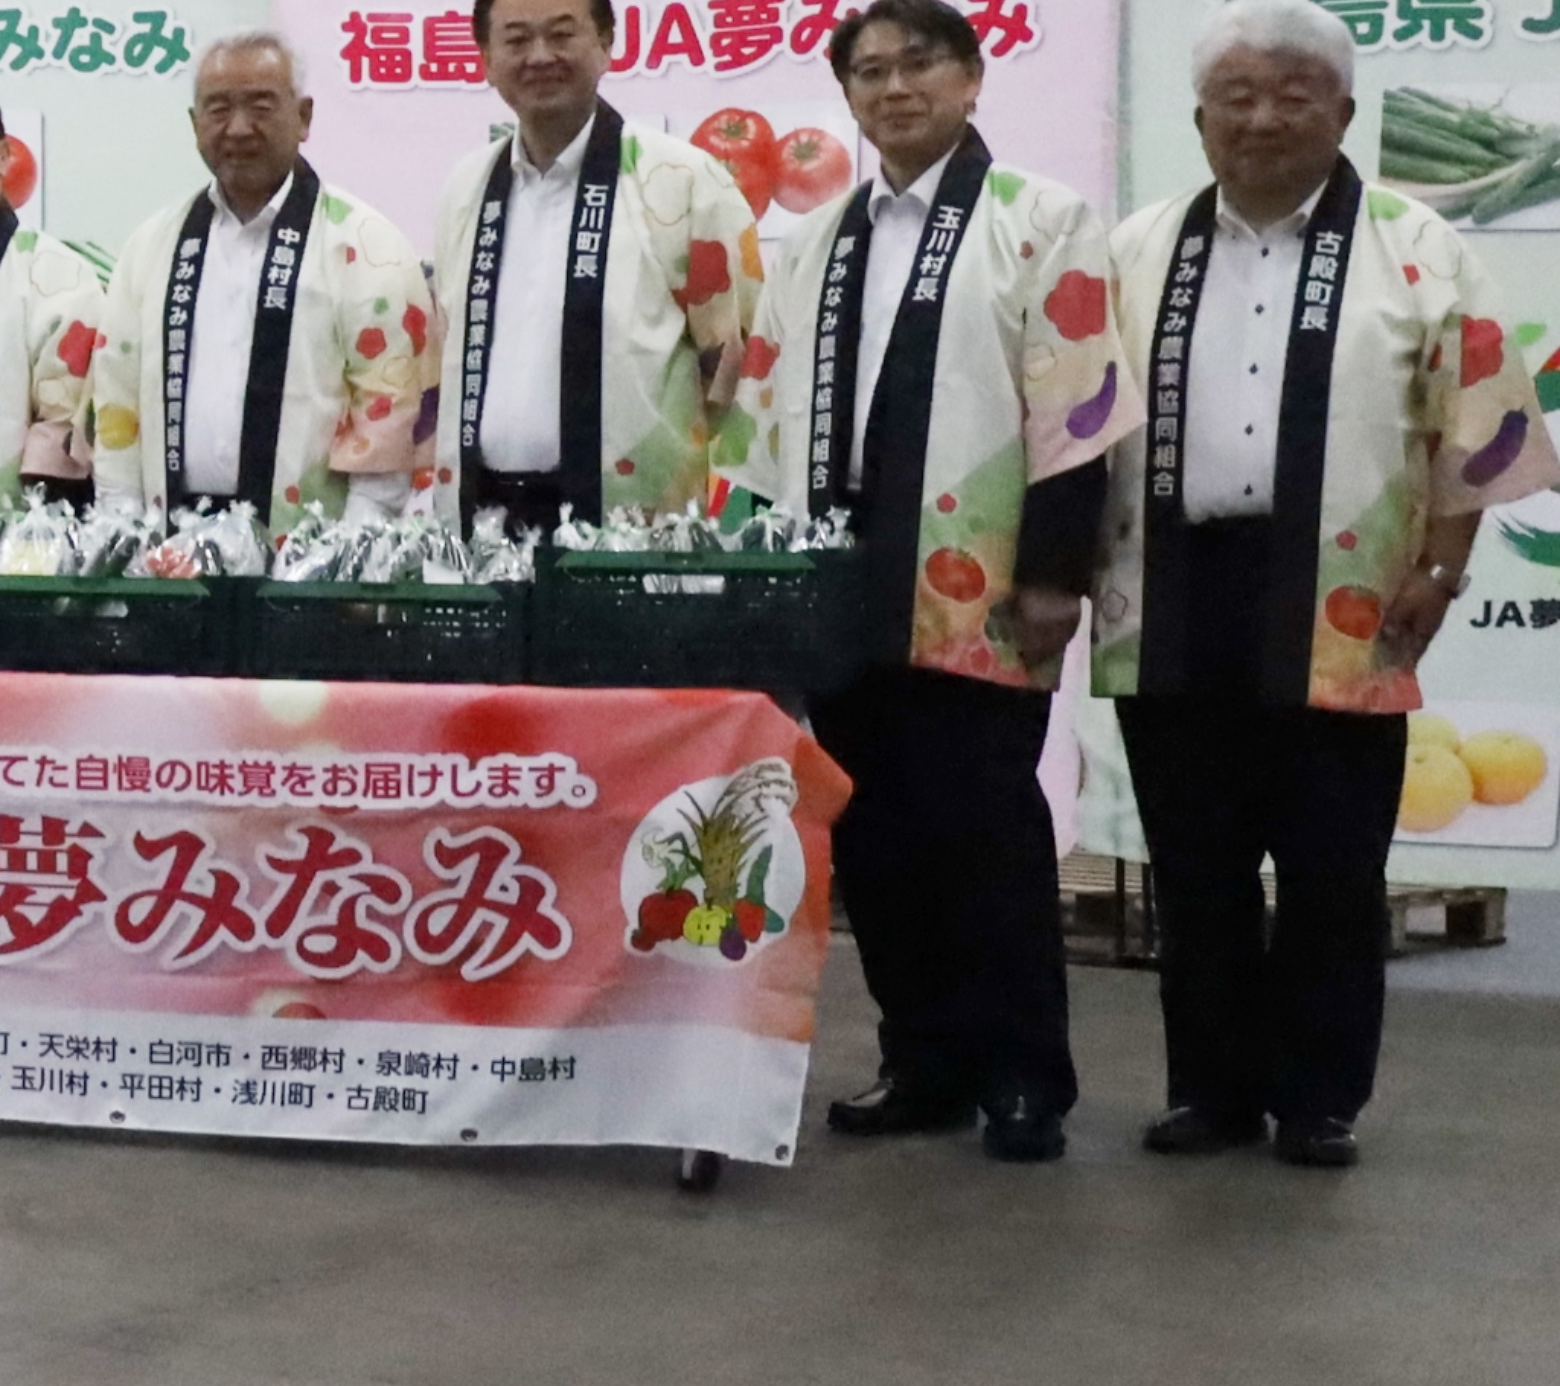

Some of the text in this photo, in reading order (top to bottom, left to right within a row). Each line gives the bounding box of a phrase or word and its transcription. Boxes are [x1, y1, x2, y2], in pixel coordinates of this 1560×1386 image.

[263, 227, 301, 311] 中島村長
[573, 183, 609, 279] 石川町長
[912, 205, 964, 303] 玉川村長
[1299, 230, 1345, 332] 古殿町長
[1152, 235, 1205, 495] 夢みなみ農業協同組合
